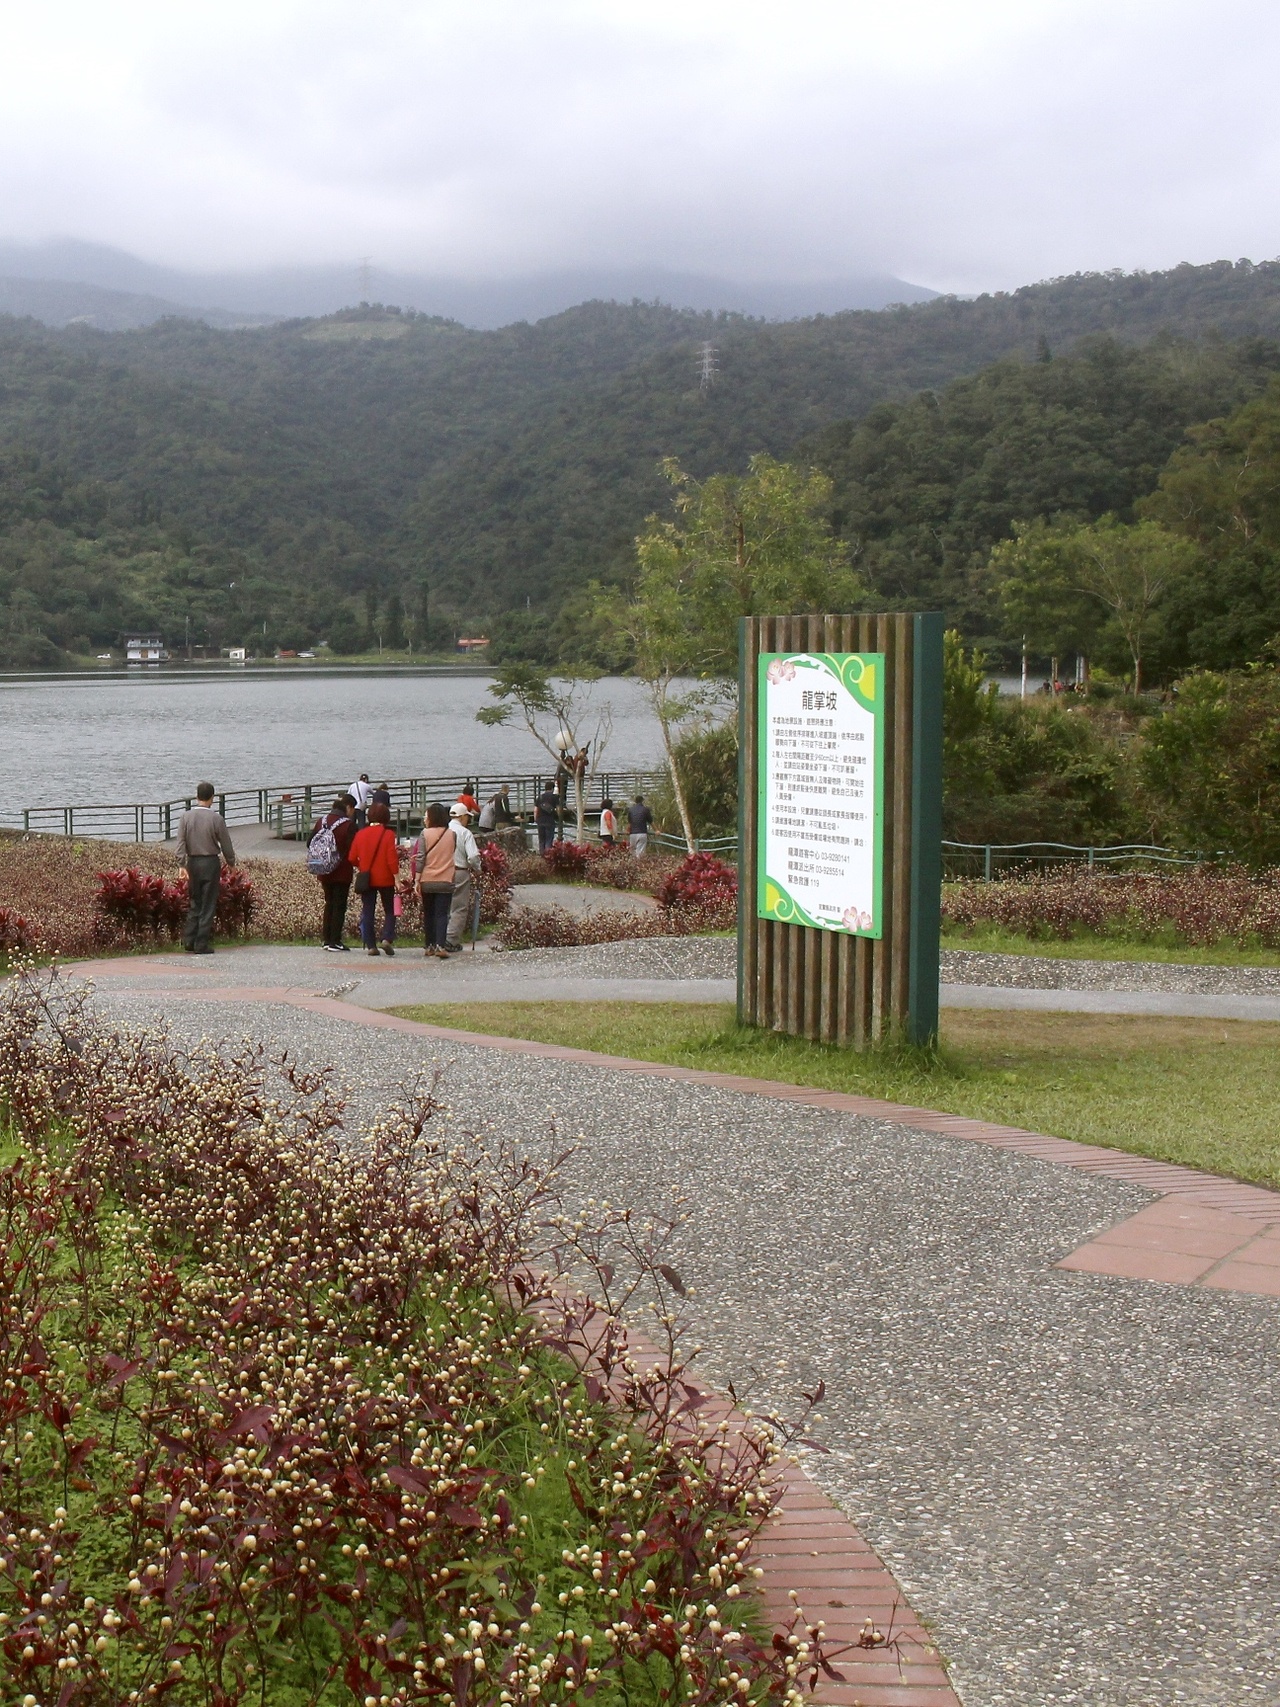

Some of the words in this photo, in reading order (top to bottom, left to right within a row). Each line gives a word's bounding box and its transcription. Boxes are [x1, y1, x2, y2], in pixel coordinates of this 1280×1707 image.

[802, 691, 837, 711] 龍掌坡
[810, 879, 819, 887] 119
